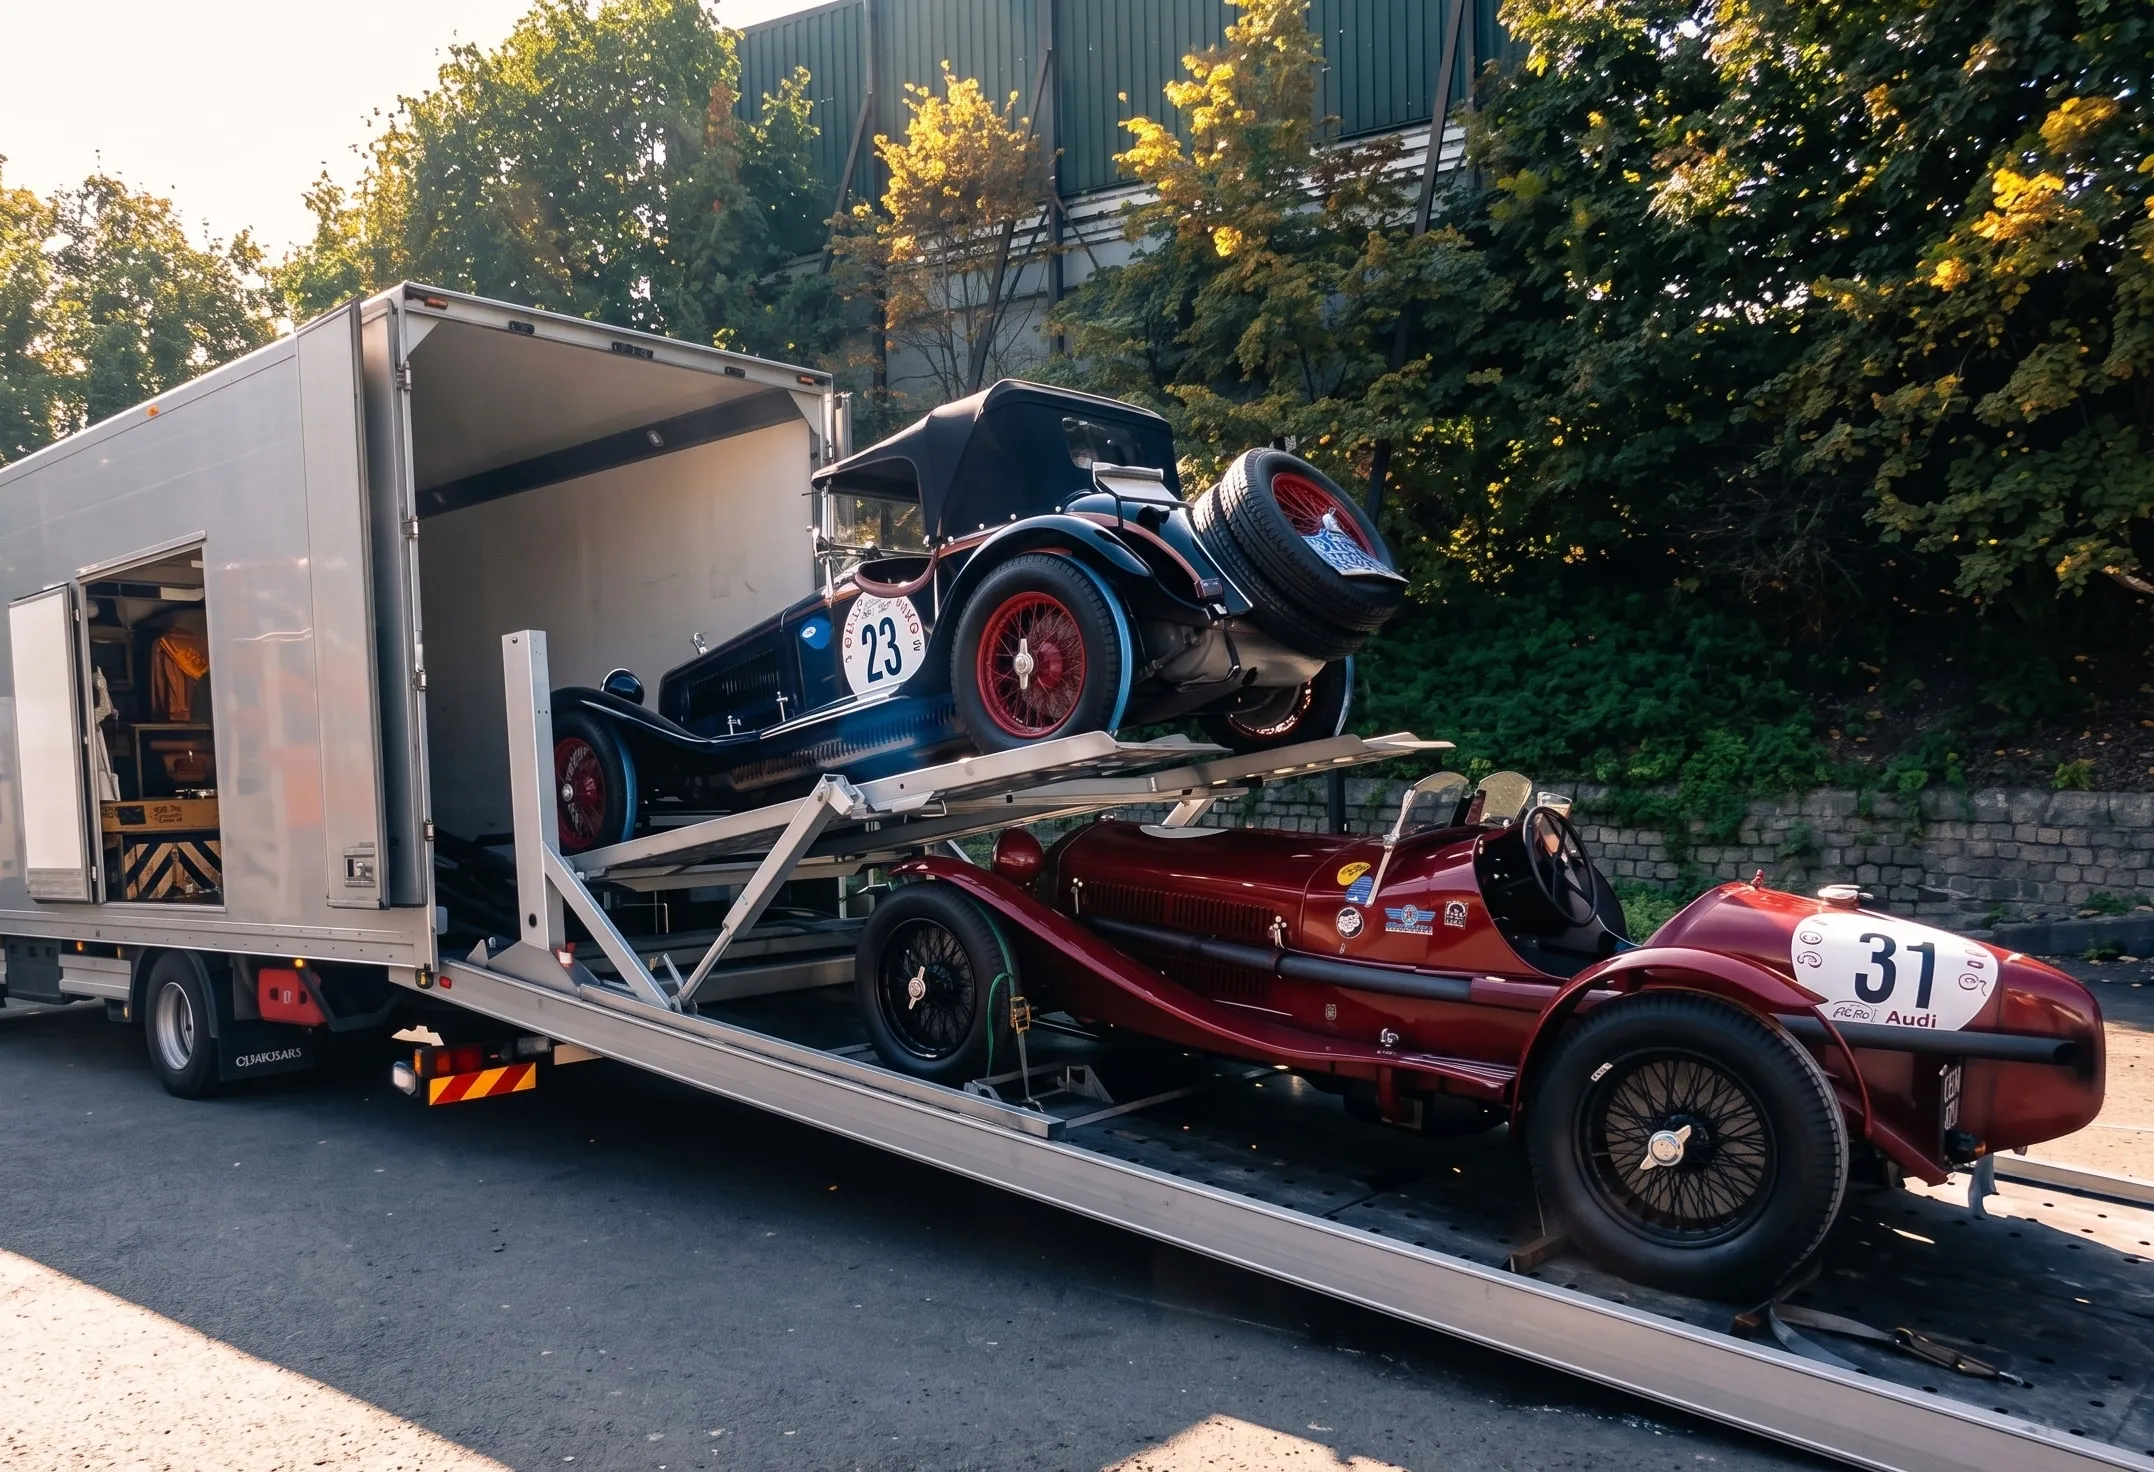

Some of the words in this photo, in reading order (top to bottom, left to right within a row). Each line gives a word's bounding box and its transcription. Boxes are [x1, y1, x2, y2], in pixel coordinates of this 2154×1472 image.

[861, 617, 902, 684] 23
[1854, 932, 1936, 1010] 31
[1885, 1010, 1937, 1029] Audi
